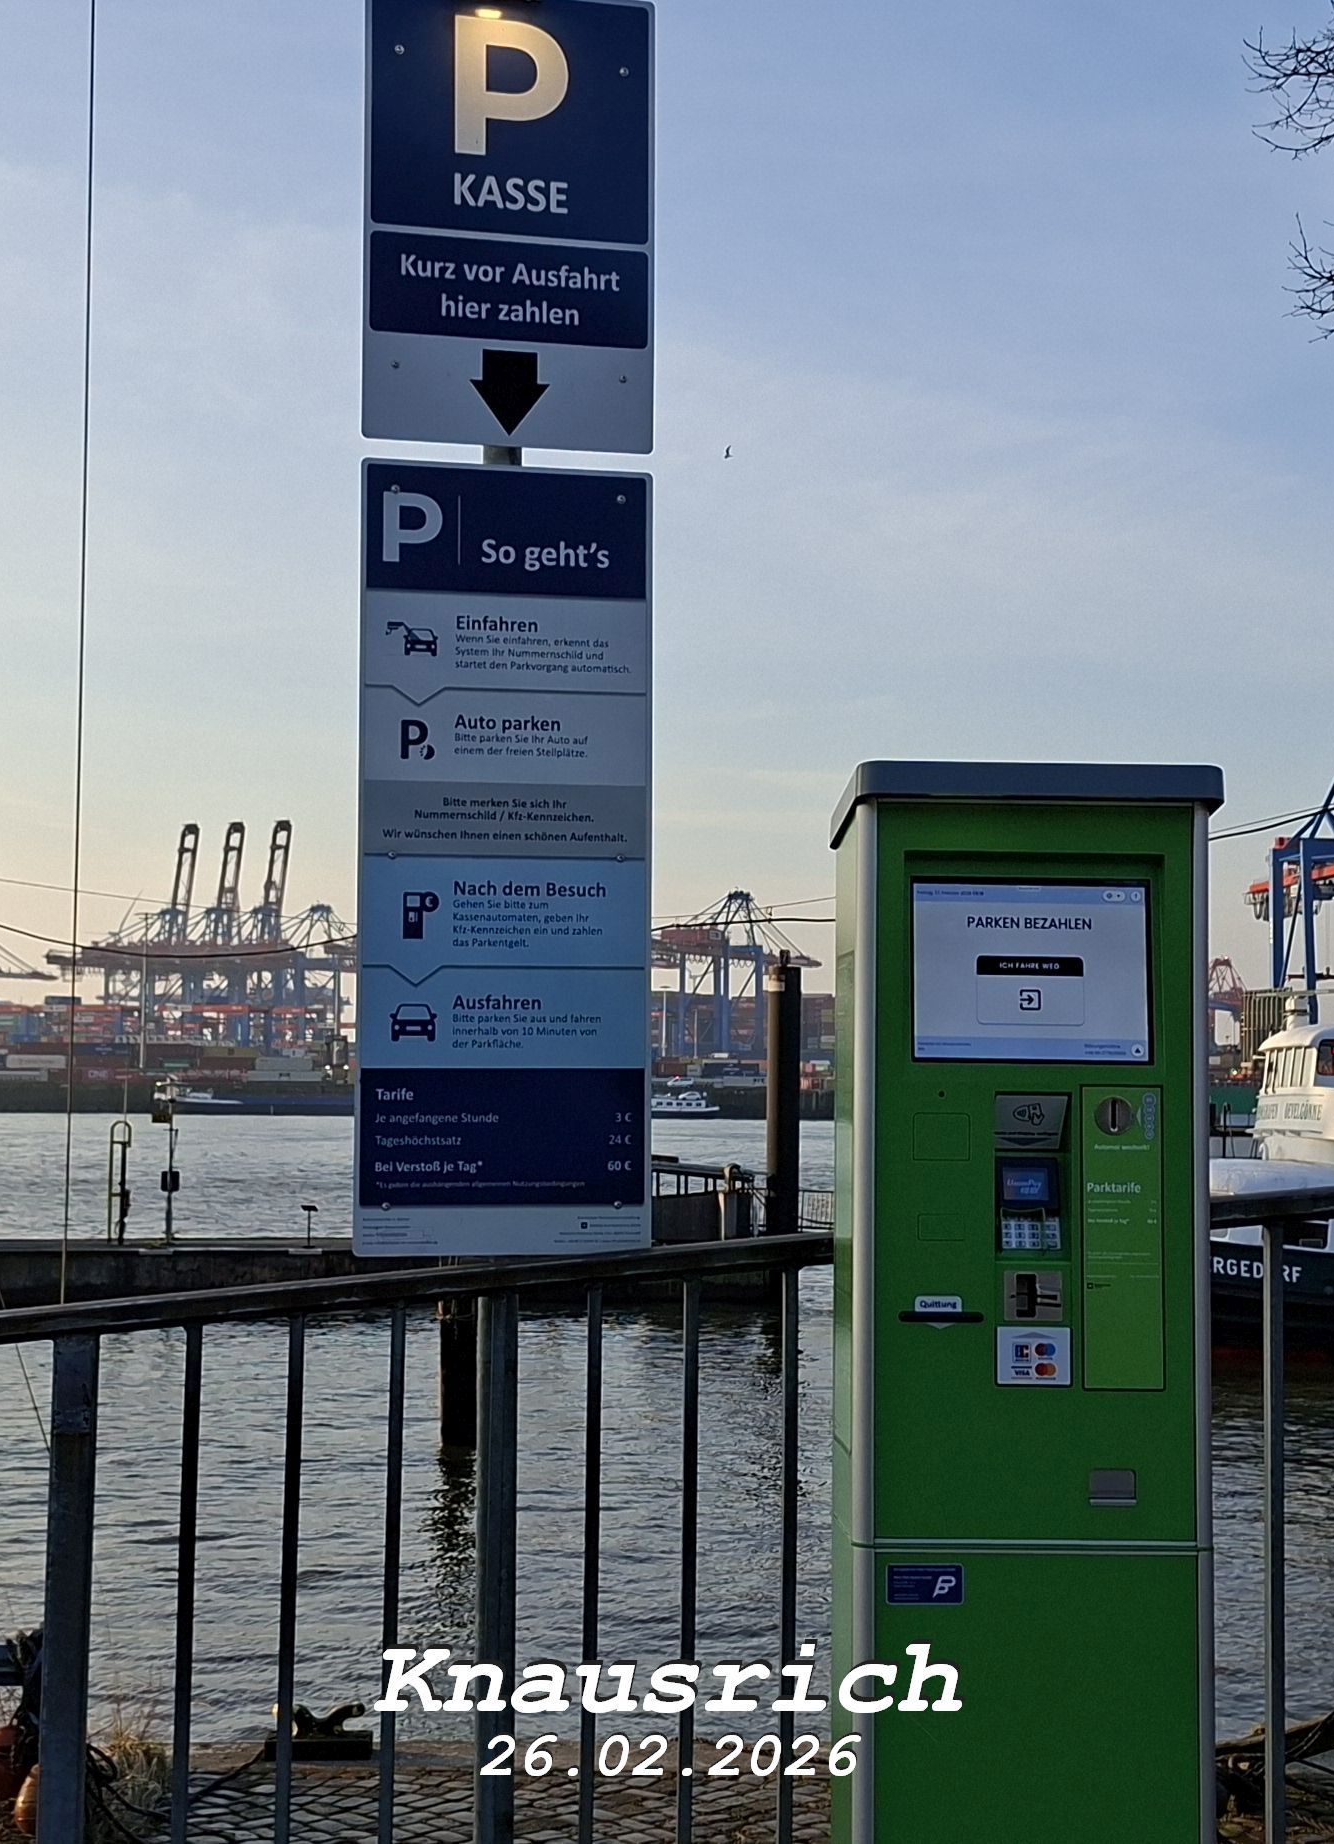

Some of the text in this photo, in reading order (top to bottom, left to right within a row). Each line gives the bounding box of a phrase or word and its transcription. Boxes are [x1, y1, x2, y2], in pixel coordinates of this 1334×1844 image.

[454, 14, 569, 156] P
[453, 172, 568, 215] KASSE
[400, 254, 620, 292] Kurz vor Ausfahrt
[440, 293, 579, 326] hier zahlen
[382, 491, 443, 562] P
[481, 539, 610, 571] So geht's
[456, 615, 538, 633] Einfahren
[455, 634, 609, 648] Wenn Sie einfahren, erkennt das
[455, 647, 604, 661] System Ihr Nummernschild und
[455, 660, 632, 674] startet den Parkvorgang automatisch.
[454, 714, 561, 733] Auto parken
[454, 733, 588, 746] Bitte parken Sie Ihr Auto auf
[454, 746, 588, 759] einem der freien Stellplätze.
[443, 797, 567, 809] Bitte merken Sie sich Ihr
[414, 809, 496, 821] Nummernschild
[507, 811, 594, 823] Kfz-Kennzeichen.
[382, 828, 627, 843] Wir wünschen Ihnen einen schönen Aufenthalt.
[453, 880, 606, 898] Nach dem Besuch
[453, 899, 549, 909] Gehen Sie bitte zum
[452, 912, 589, 925] Kassenautomaten, geben Ihr
[967, 916, 1092, 930] PARKEN BEZAHLEN
[452, 925, 603, 936] Kfz-Kennzeichen ein und zahlen
[452, 938, 529, 949] das Parkentgelt.
[452, 995, 542, 1011] Ausfahren
[452, 1013, 475, 1023] Bitte
[478, 1014, 511, 1026] parken
[513, 1014, 528, 1023] Sie
[549, 1014, 568, 1023] und
[570, 1014, 602, 1024] fahren
[452, 1026, 597, 1036] innerhalb von 10 Minuten von
[452, 1039, 524, 1049] der Parkfläche.
[376, 1088, 414, 1101] Tarife
[375, 1112, 632, 1125] Je angefangene Stunde 3 €
[375, 1135, 632, 1147] Tageshöchstsatz 24 €
[375, 1161, 393, 1172] Bei
[396, 1161, 441, 1172] Verstoß
[443, 1161, 454, 1173] je
[607, 1160, 622, 1171] 60
[624, 1160, 632, 1171] €
[1087, 1182, 1141, 1193] Parktarife
[1211, 1256, 1302, 1283] RGEDRF
[919, 1300, 957, 1310] Quittung
